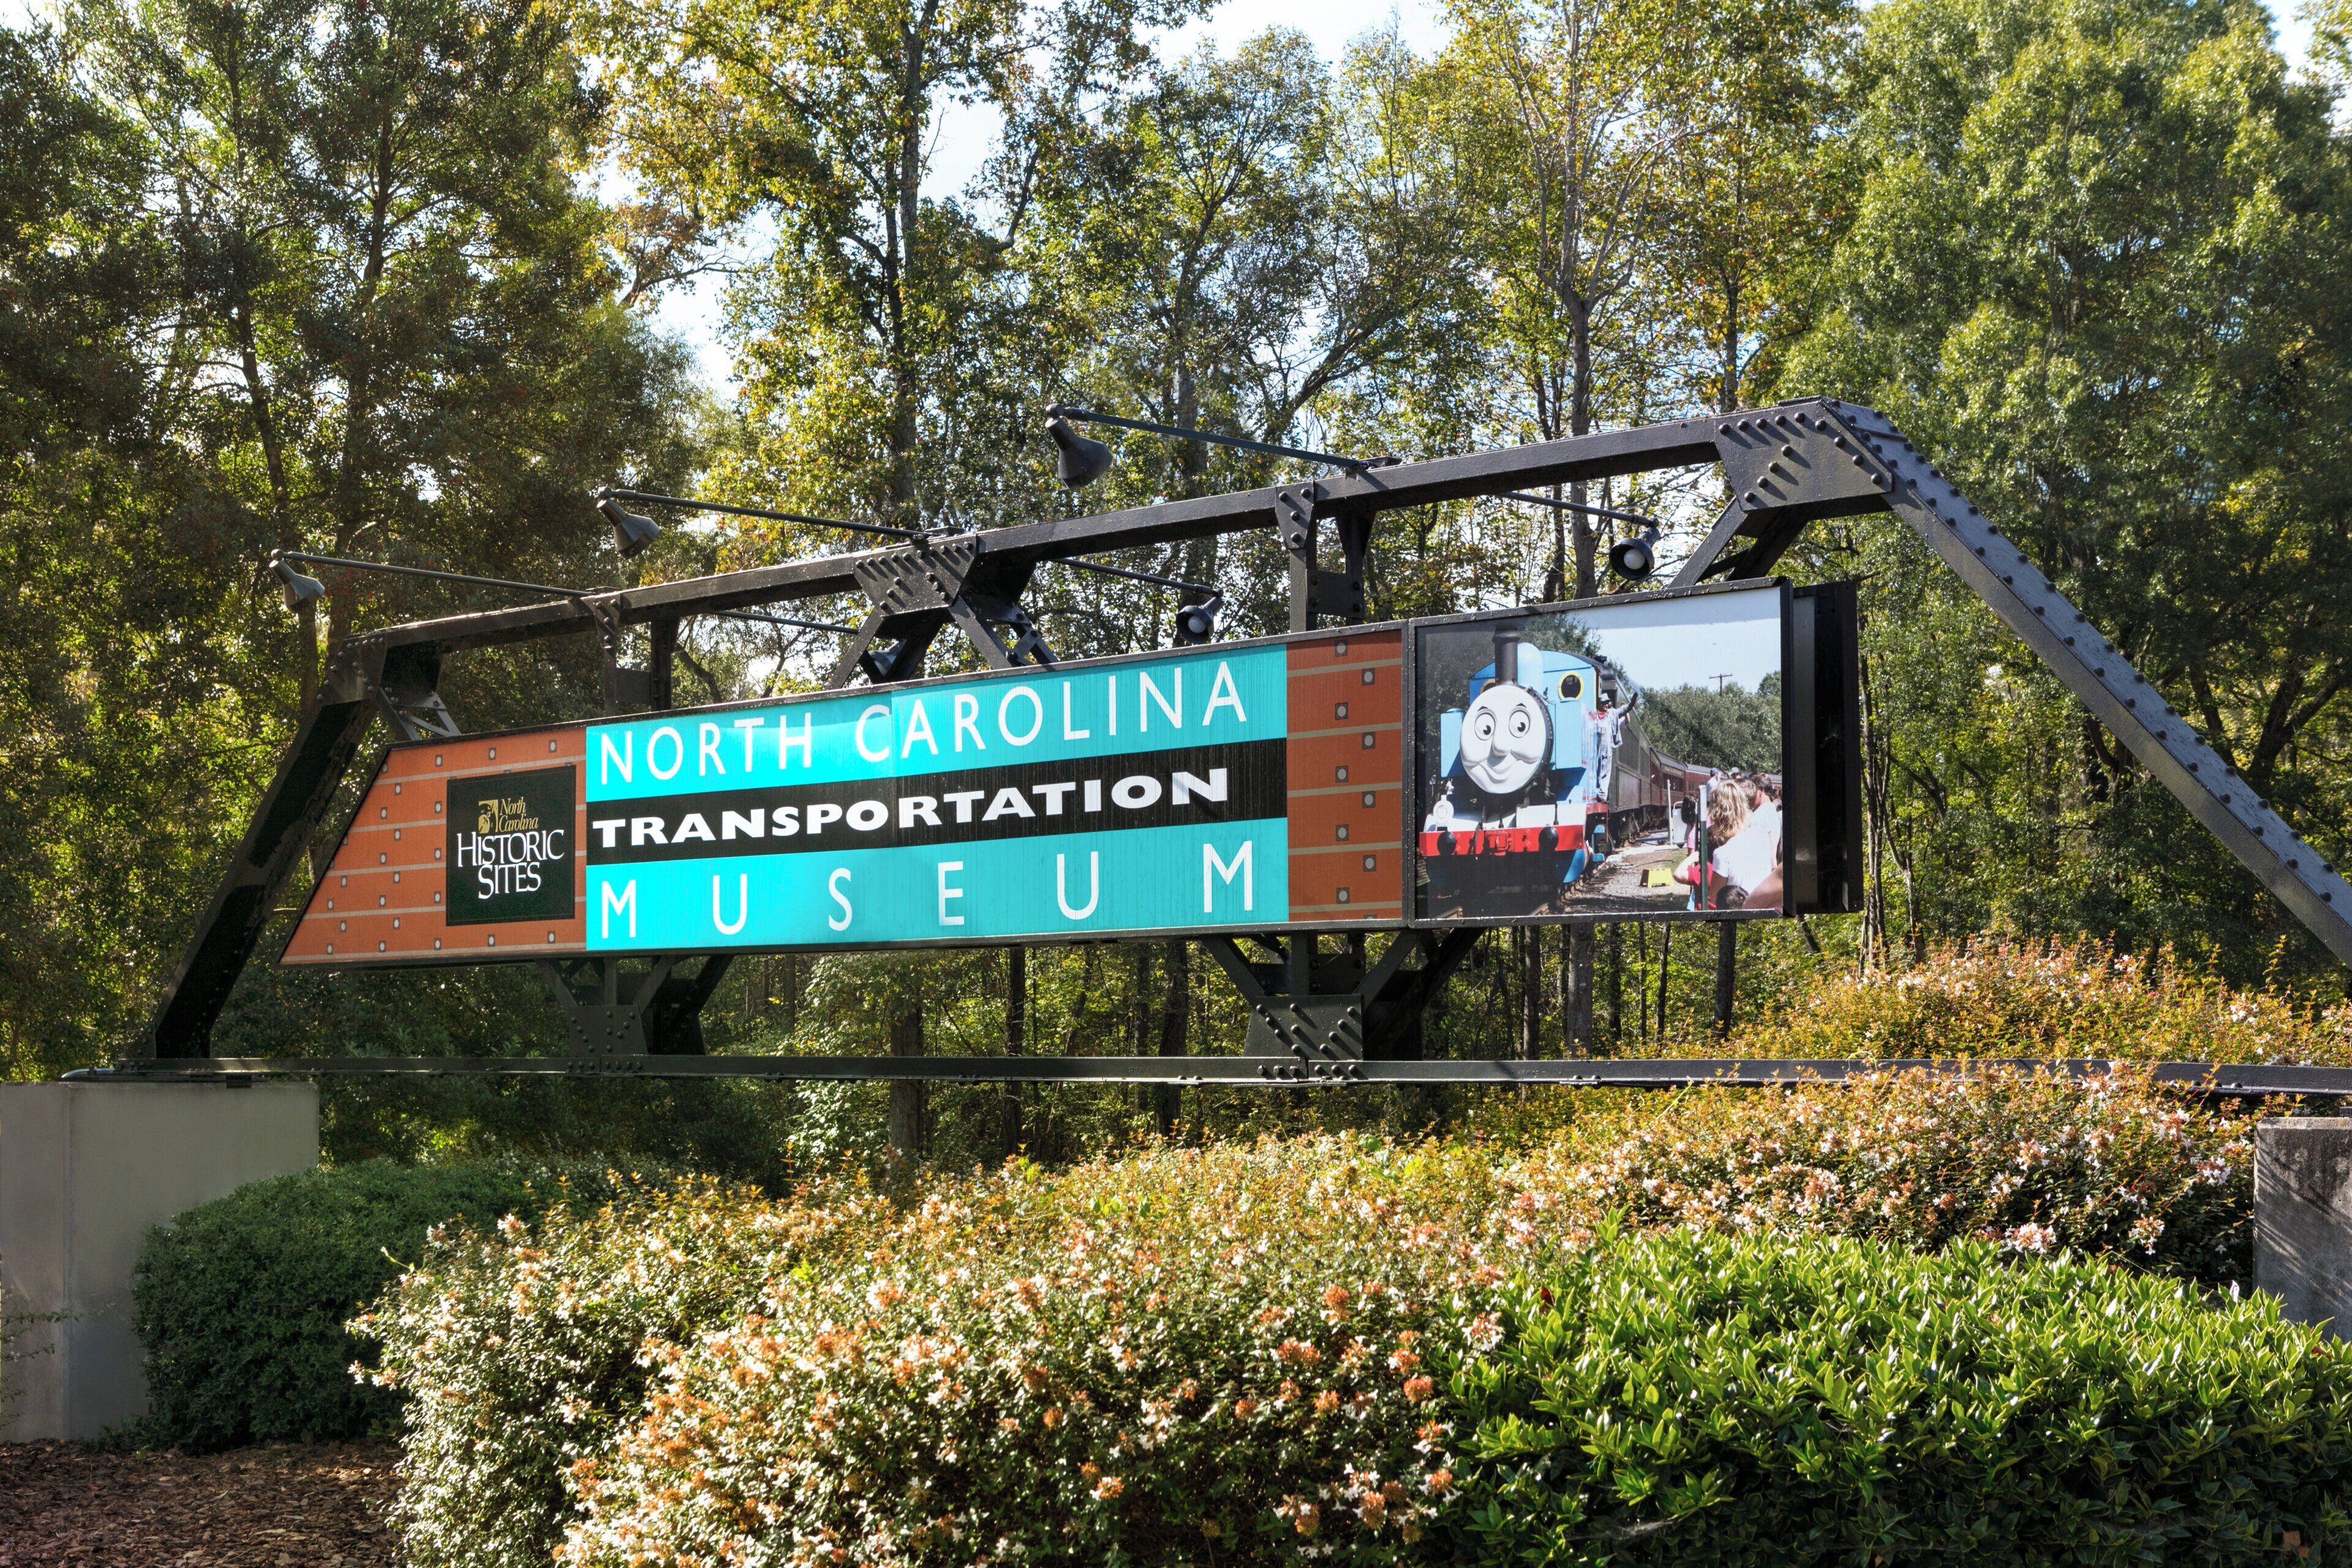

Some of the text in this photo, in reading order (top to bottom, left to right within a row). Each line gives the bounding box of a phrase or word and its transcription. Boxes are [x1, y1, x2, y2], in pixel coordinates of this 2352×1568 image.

[601, 662, 1247, 785] NORTH CAROLINA
[499, 797, 526, 816] North
[499, 813, 539, 833] Carolina
[593, 768, 1227, 848] TRANSPORTATION
[457, 829, 565, 867] HISTORIC
[478, 862, 541, 899] SITES
[601, 840, 1253, 938] MUSEUM
